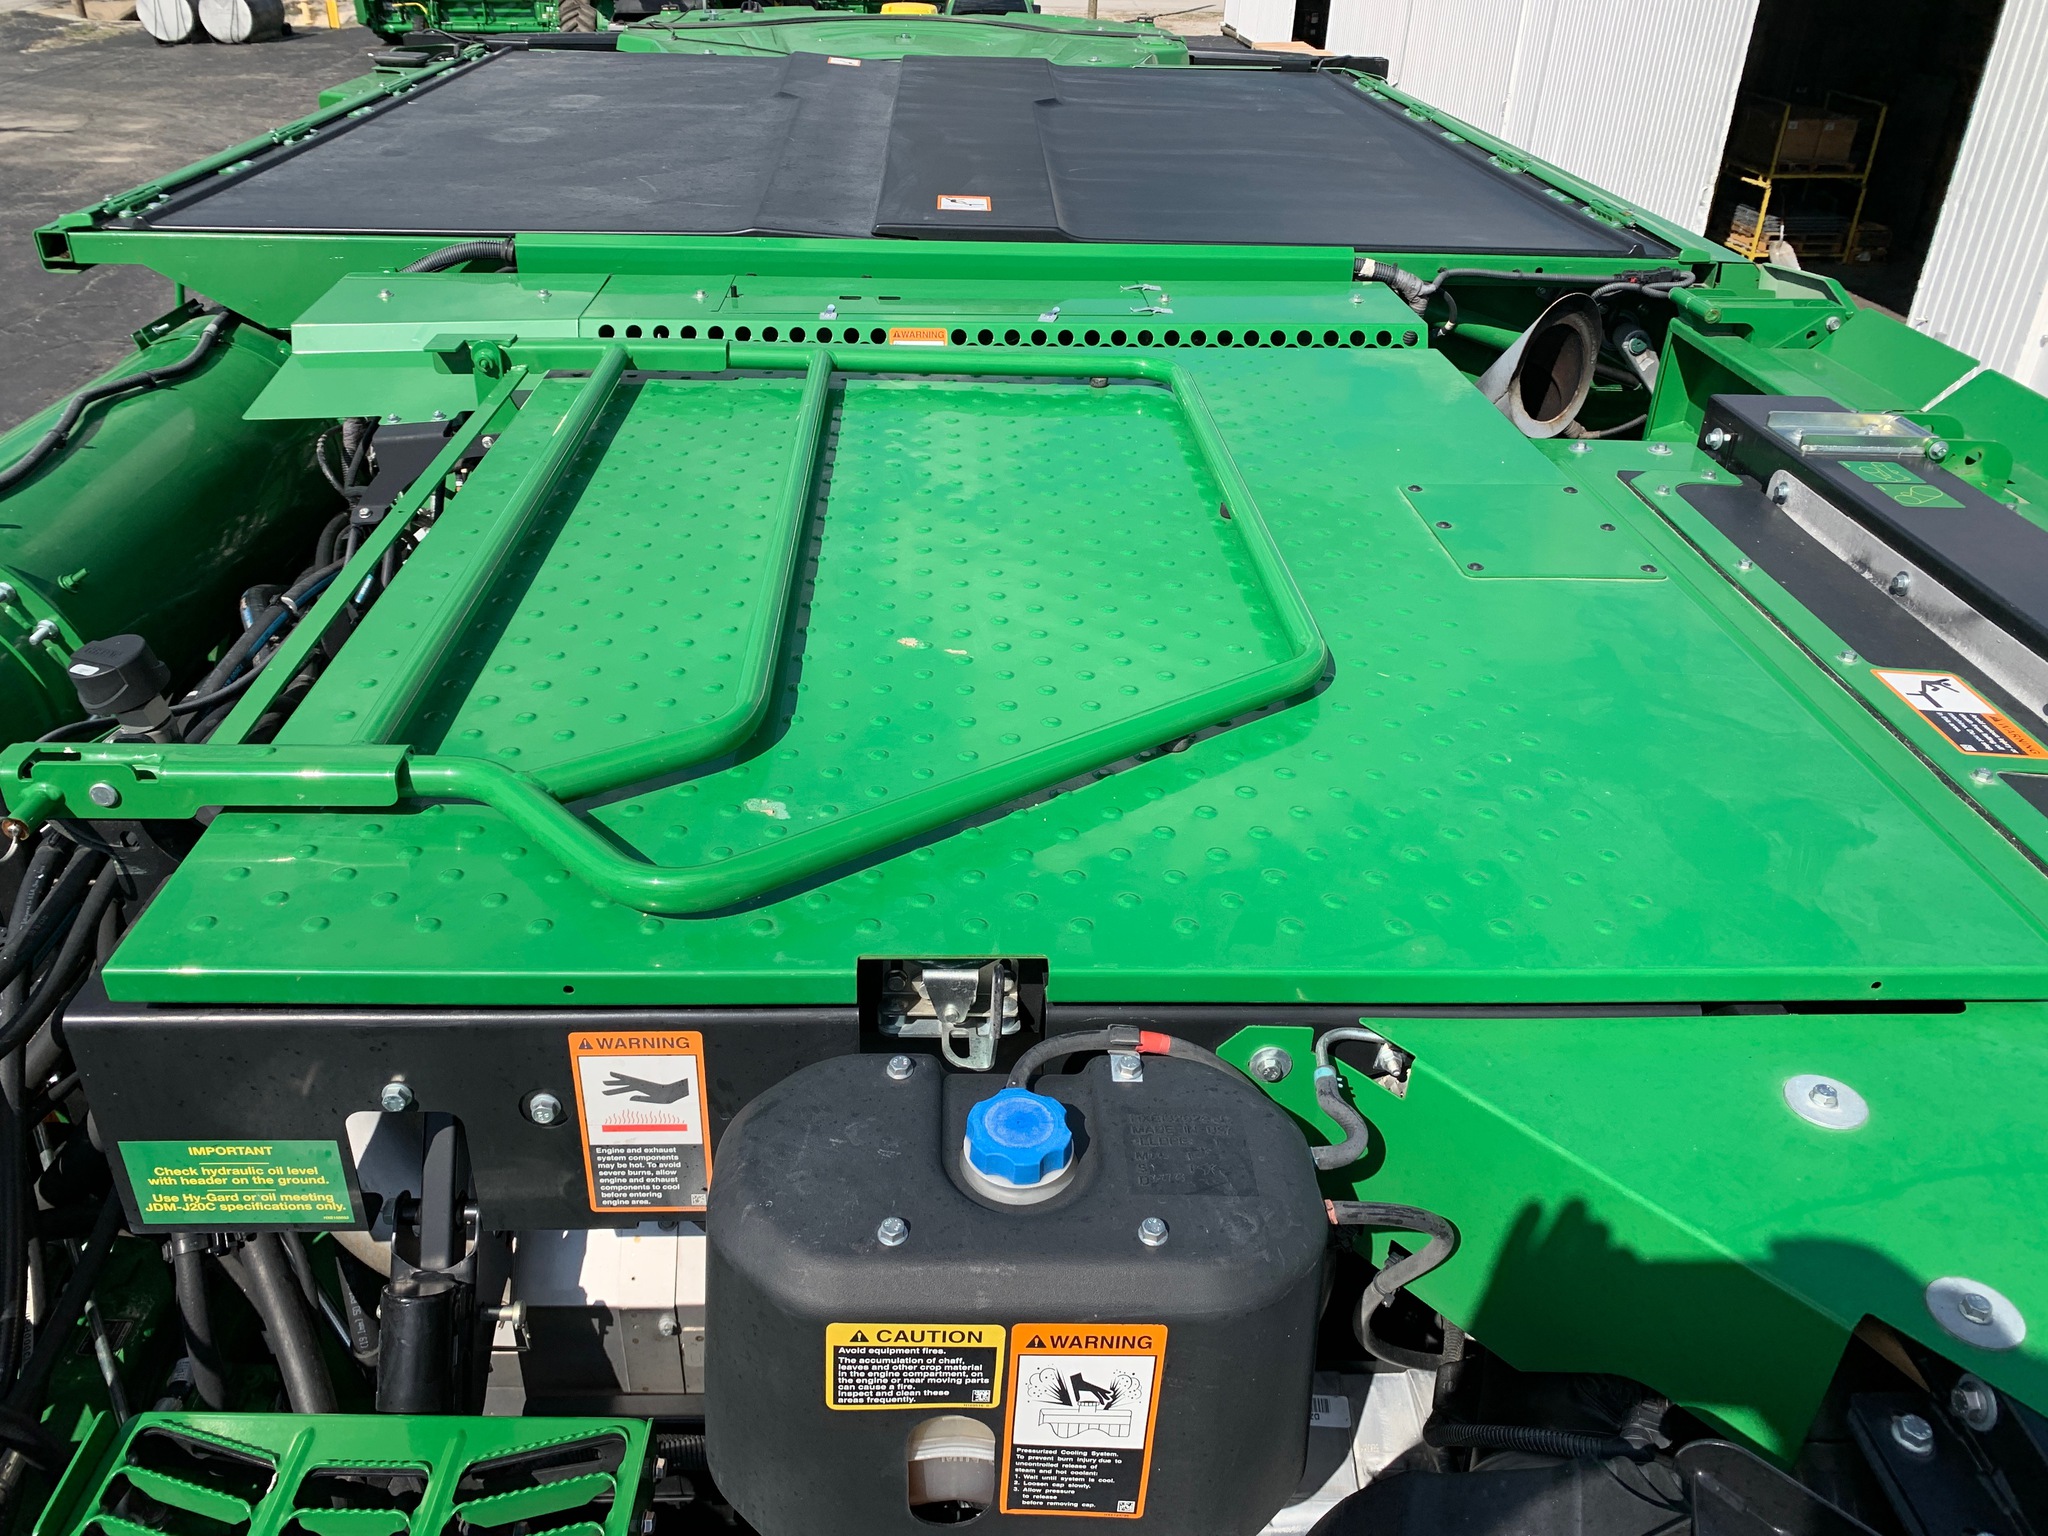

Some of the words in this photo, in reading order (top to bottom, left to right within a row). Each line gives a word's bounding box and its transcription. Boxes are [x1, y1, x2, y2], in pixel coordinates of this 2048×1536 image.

[1999, 724, 2040, 754] WARNING
[596, 1037, 689, 1049] WARNING
[188, 1147, 272, 1155] IMPORTANT
[154, 1167, 197, 1176] Check
[201, 1167, 264, 1178] hydraulic
[267, 1167, 283, 1175] oil
[287, 1167, 318, 1175] level
[148, 1176, 177, 1185] with
[181, 1176, 227, 1185] header
[252, 1176, 274, 1185] the
[278, 1176, 329, 1186] ground.
[153, 1194, 179, 1202] Use
[183, 1194, 238, 1204] Hy-Gard
[260, 1194, 276, 1202] oil
[280, 1194, 334, 1203] meeting
[146, 1203, 216, 1212] JDM-J20C
[220, 1202, 312, 1212] specifications
[316, 1203, 346, 1212] only.
[876, 1330, 982, 1343] CAUTION
[1050, 1336, 1152, 1349] WARNING
